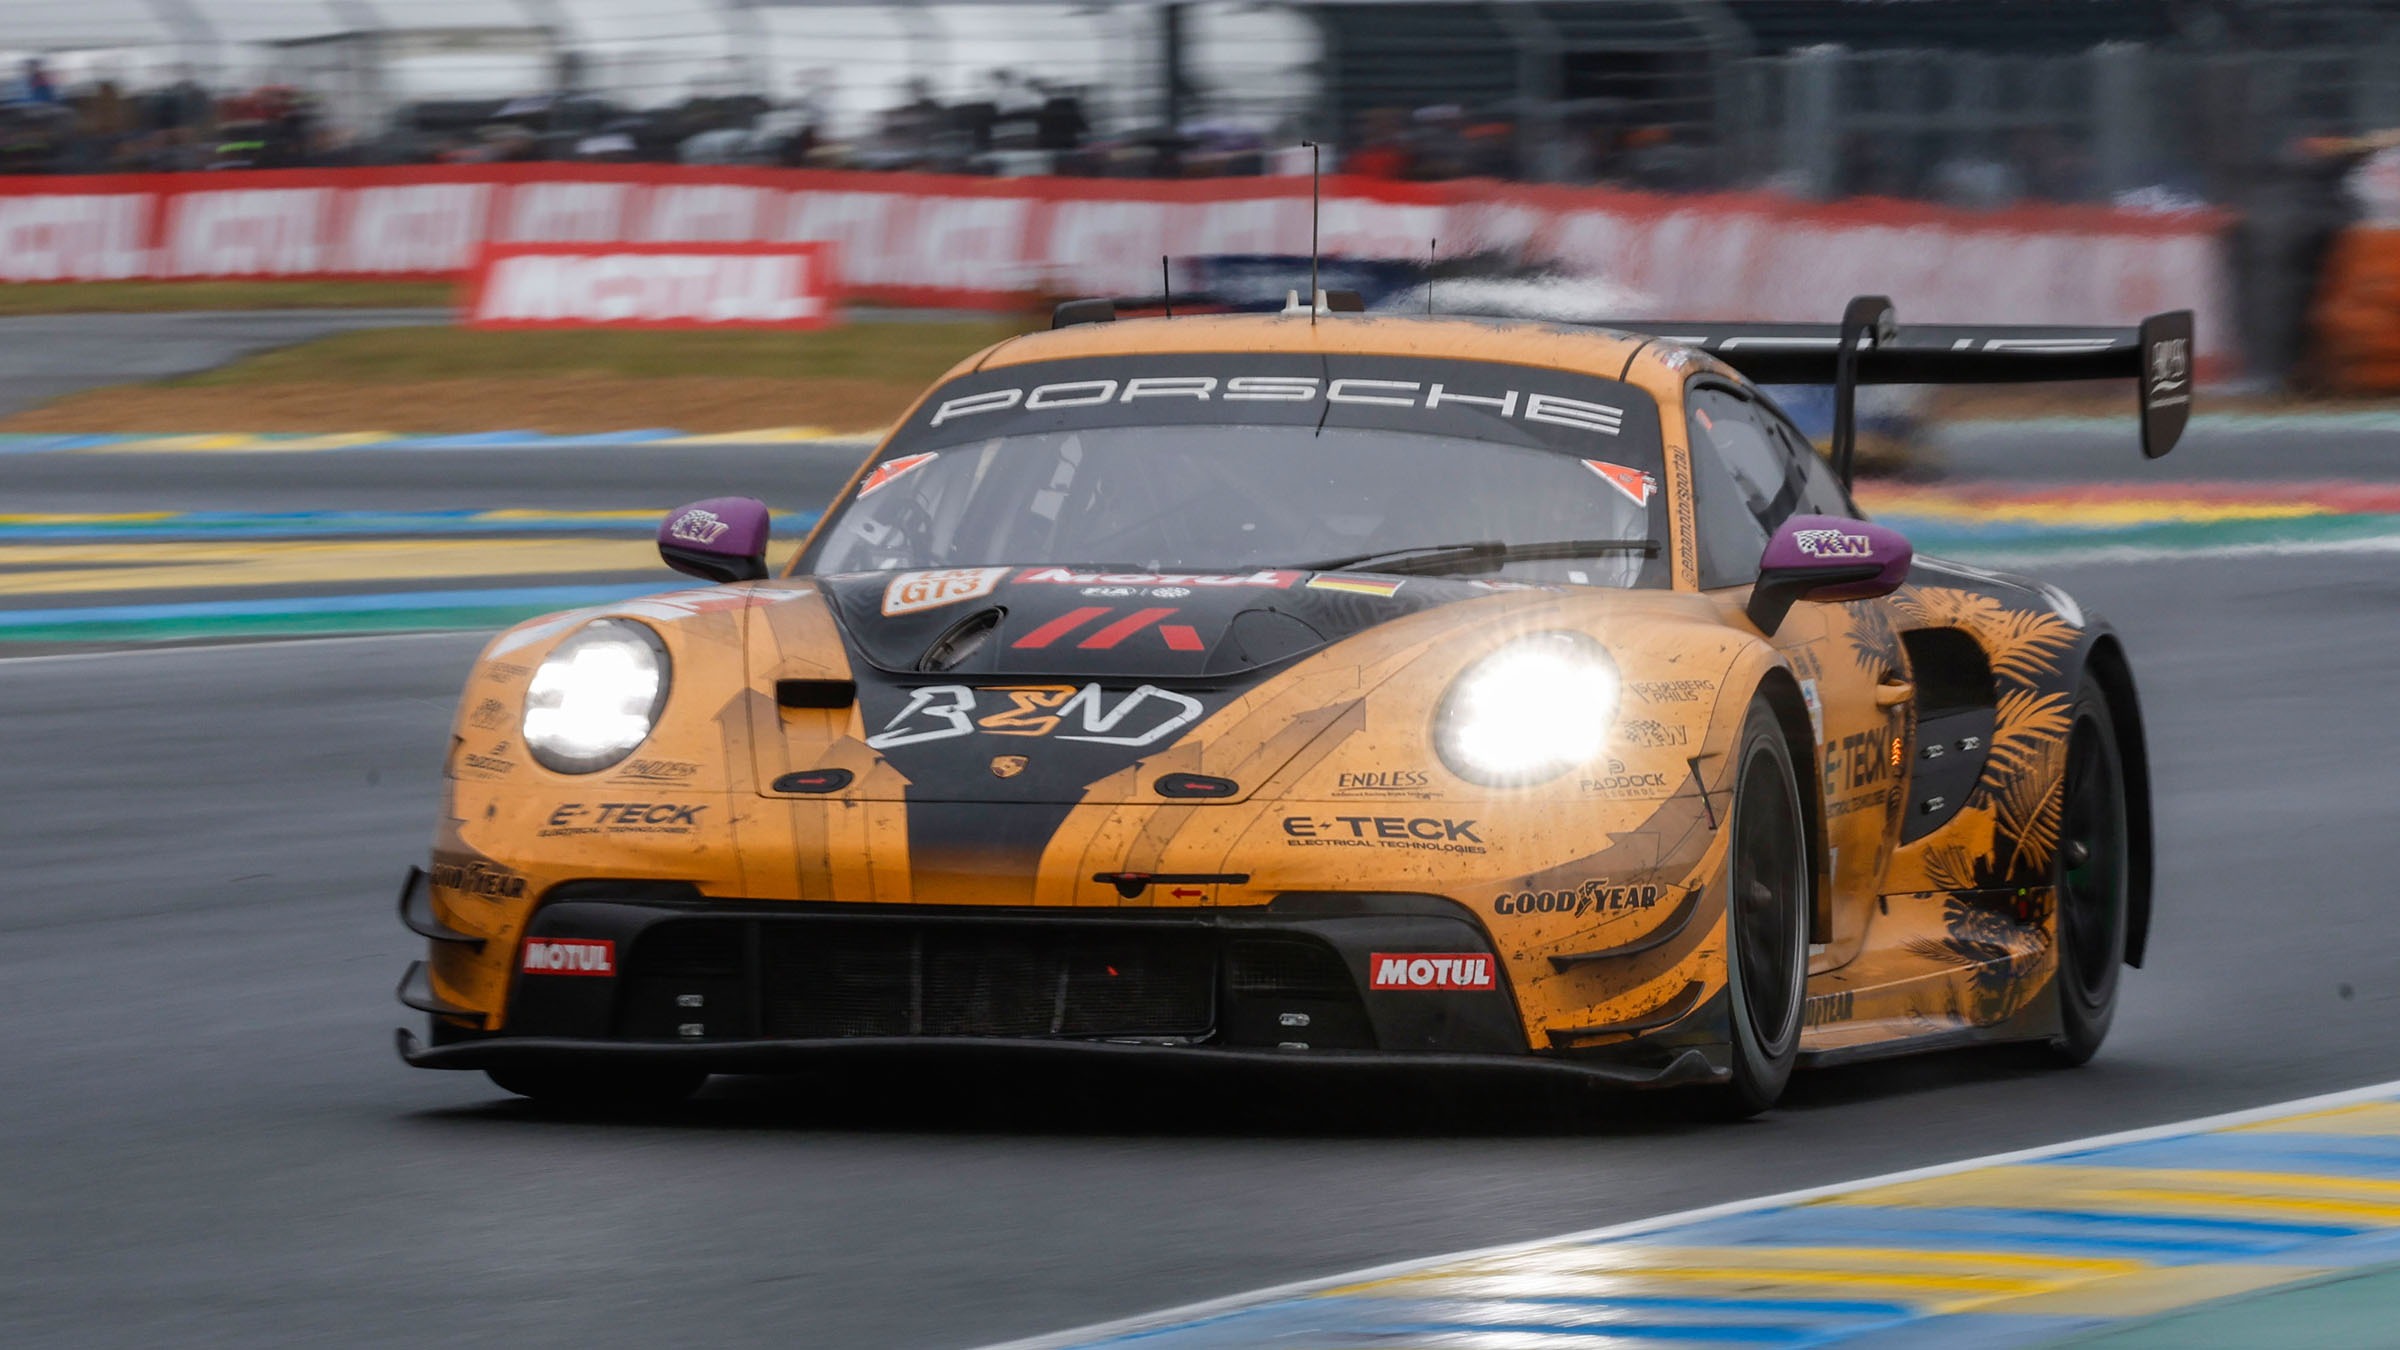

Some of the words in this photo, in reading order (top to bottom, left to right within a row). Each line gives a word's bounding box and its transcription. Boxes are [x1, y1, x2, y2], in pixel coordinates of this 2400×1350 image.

[930, 376, 1624, 437] PORSCHE
[1027, 568, 1279, 584] MOTUL
[901, 577, 979, 604] GT3
[1337, 771, 1430, 788] ENDLESS
[1580, 772, 1667, 793] PADDOCK
[1283, 816, 1483, 844] E-TECK
[1288, 839, 1375, 848] ELECTRICAL
[1378, 840, 1487, 855] TECHNOLOGIES
[524, 942, 611, 972] MOTUL
[1376, 959, 1490, 985] MOTUL
